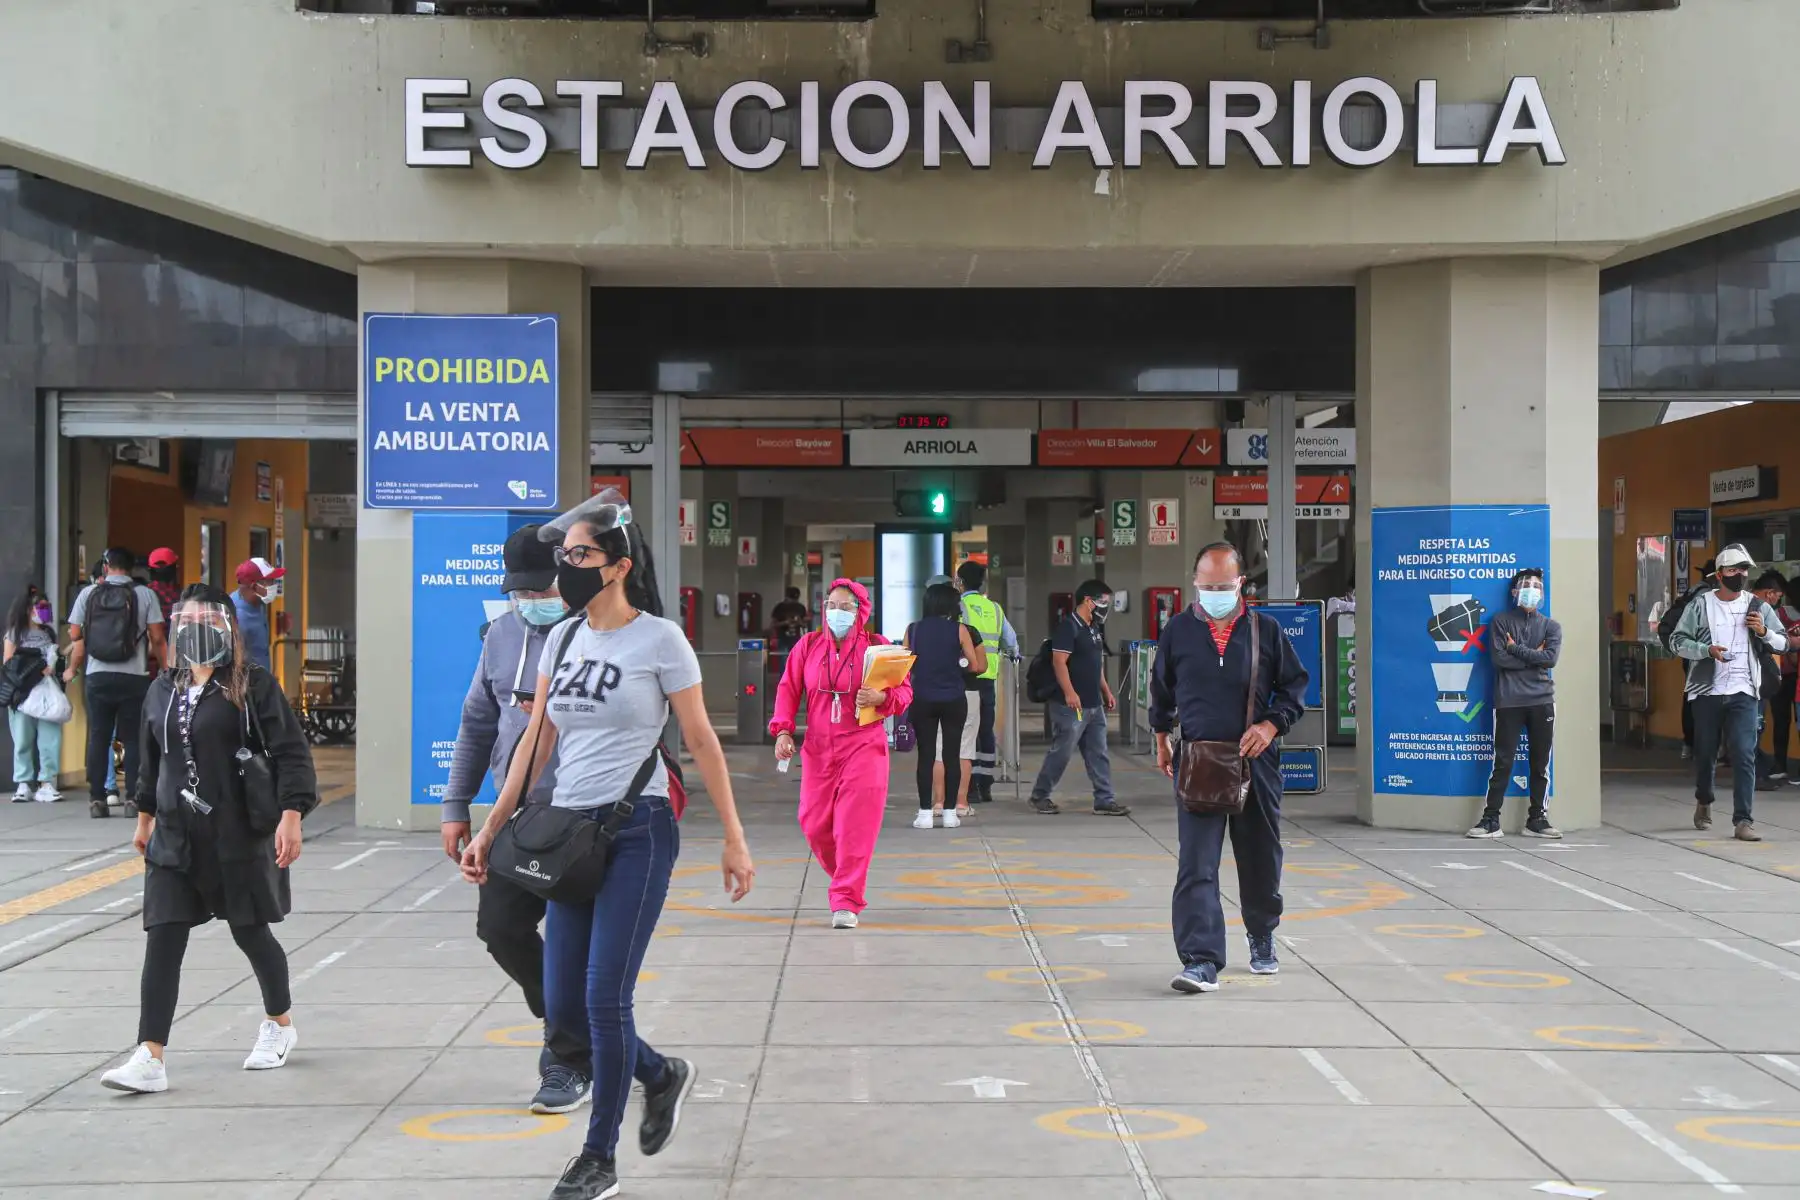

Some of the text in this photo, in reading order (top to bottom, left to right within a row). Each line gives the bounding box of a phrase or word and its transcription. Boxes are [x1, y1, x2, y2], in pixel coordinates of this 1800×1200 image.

[405, 76, 1567, 169] ESTACION ARRIOLA
[375, 357, 550, 384] PROHIBIDA
[405, 401, 520, 422] LA VENTA
[373, 431, 550, 451] AMBULATORIA
[795, 438, 832, 449] Bayóvar
[903, 440, 978, 454] ARRIOLA
[1086, 438, 1106, 448] Villa
[1107, 438, 1116, 448] El
[1118, 438, 1158, 448] Salvador
[1295, 436, 1339, 446] Atención
[1294, 448, 1347, 458] referencial
[1712, 477, 1755, 493] Venta de tarjetas
[711, 503, 727, 528] S
[1116, 502, 1132, 527] S
[1082, 537, 1091, 554] S
[1419, 538, 1490, 550] RESPETA LAS
[445, 559, 499, 570] MEDIDAS
[1398, 553, 1517, 566] MEDIDAS PERMITIDAS
[421, 574, 506, 585] PARA EL INGRE
[1378, 569, 1404, 581] PARA
[1406, 569, 1418, 580] EL
[1419, 568, 1466, 580] INGRESO
[1468, 568, 1494, 579] CON
[1283, 626, 1304, 637] AQUÍ
[1389, 732, 1410, 740] ANTES
[1420, 733, 1453, 741] INGRESAR
[1465, 734, 1494, 742] SISTEM
[432, 741, 456, 749] ANTES
[1389, 742, 1436, 751] PERTENENCIAS
[1436, 743, 1446, 751] EN
[1394, 752, 1424, 760] UBICADO
[1425, 753, 1450, 761] FRENTE
[1457, 753, 1472, 761] LOS
